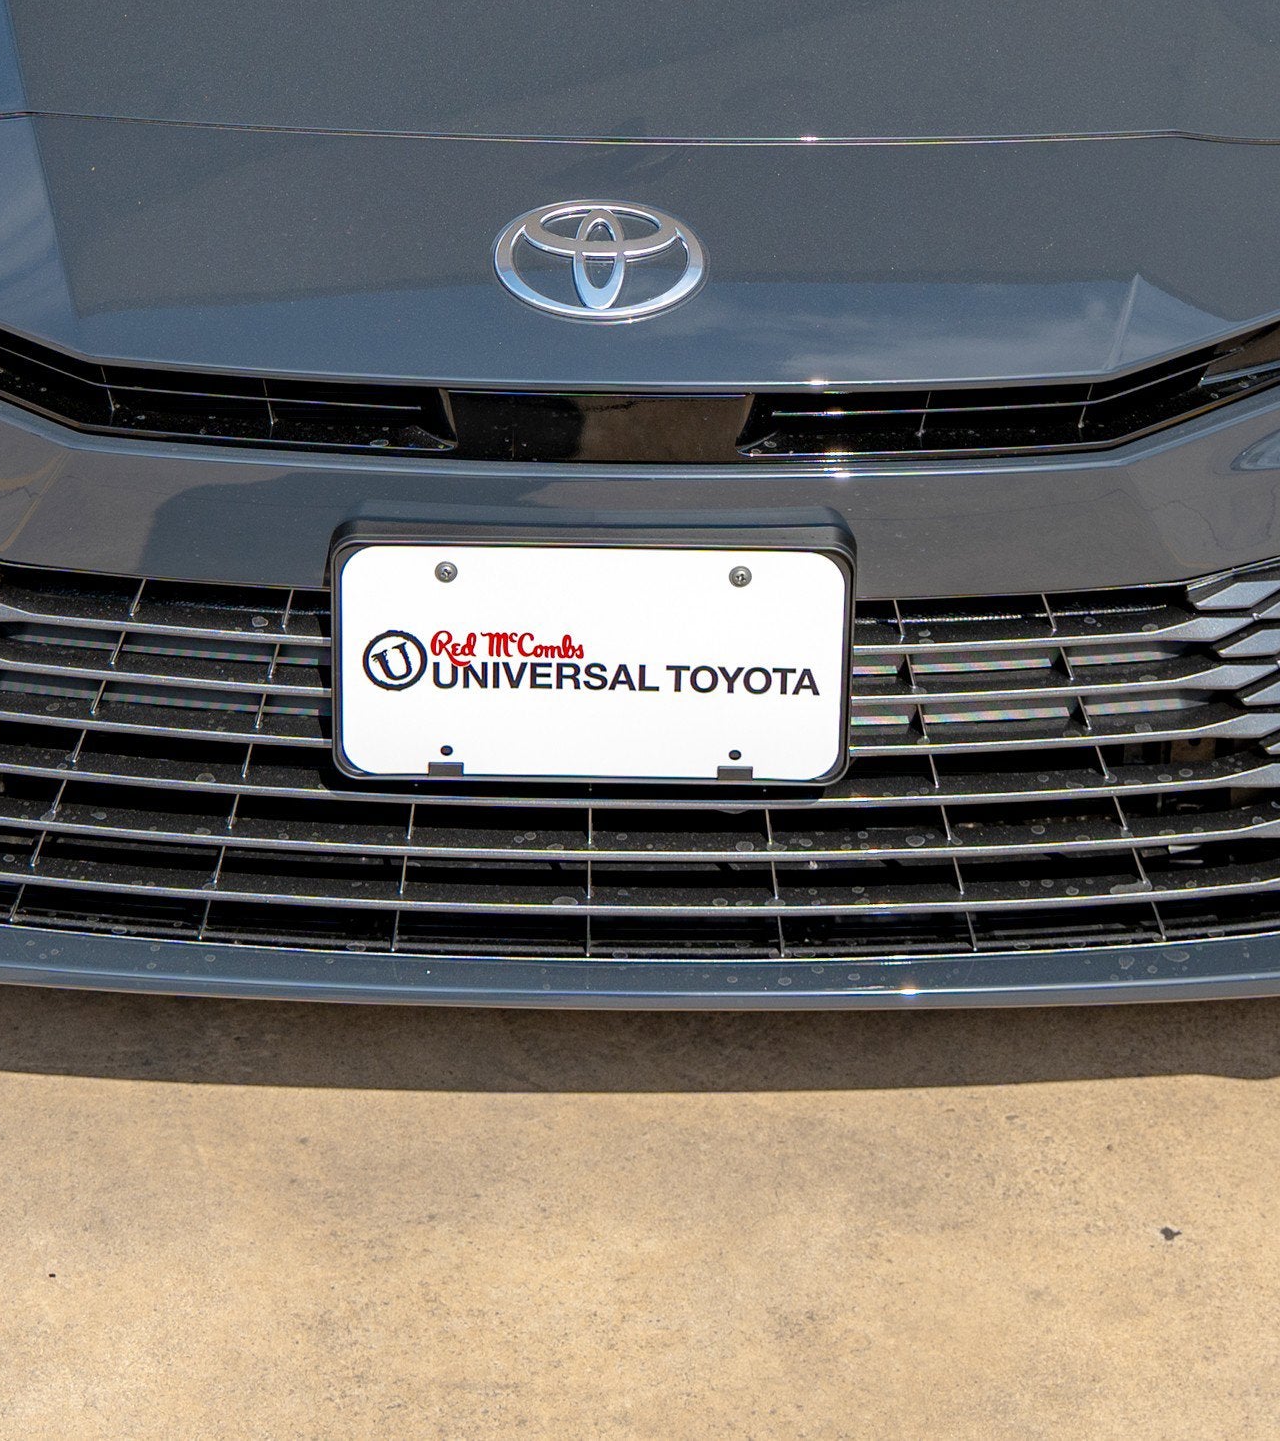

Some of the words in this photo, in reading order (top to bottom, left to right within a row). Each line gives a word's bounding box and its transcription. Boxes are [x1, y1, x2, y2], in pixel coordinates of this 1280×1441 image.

[430, 630, 477, 667] Red
[480, 632, 585, 660] McCombs
[432, 661, 660, 692] UNIVERSAL
[665, 665, 821, 696] TOYOTA
